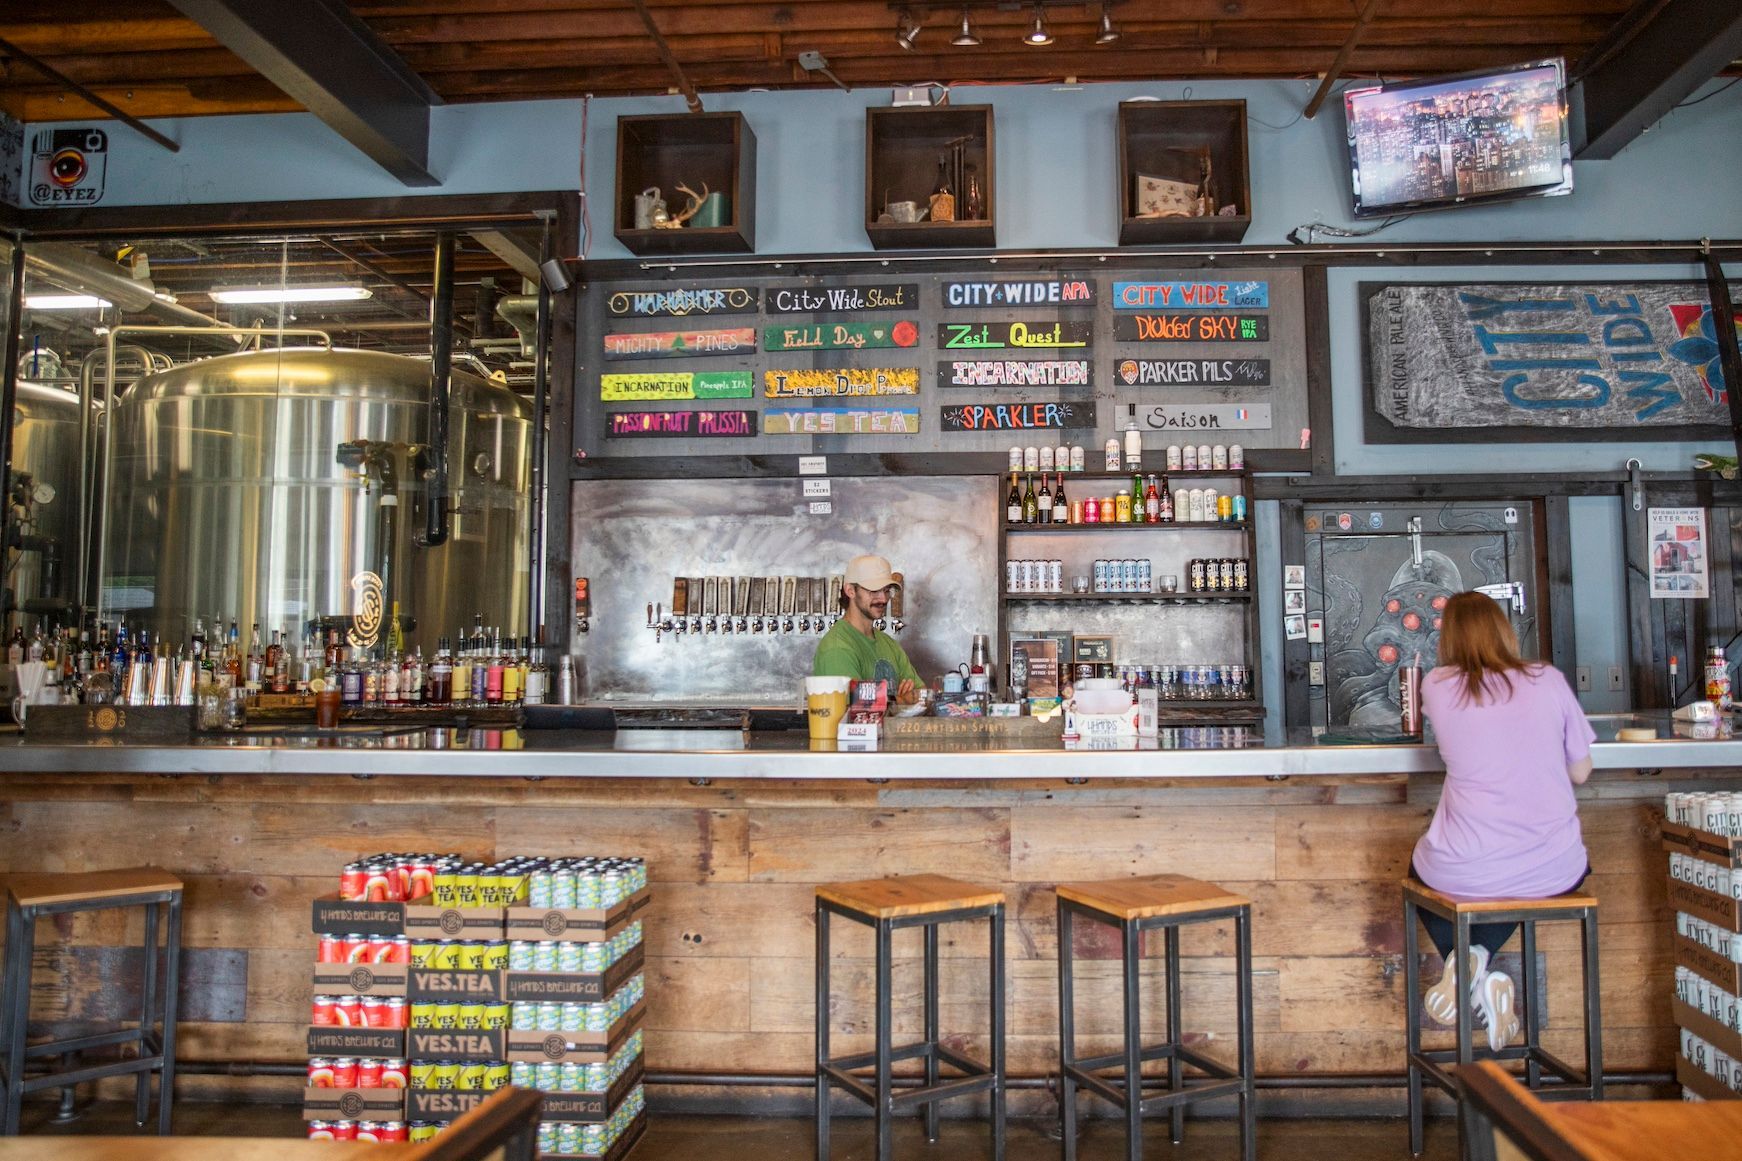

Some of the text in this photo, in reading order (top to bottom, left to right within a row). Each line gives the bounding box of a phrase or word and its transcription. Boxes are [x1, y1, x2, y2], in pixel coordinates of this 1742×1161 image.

[33, 184, 97, 201] @EYEZ
[776, 286, 904, 311] City Wide Stout
[949, 281, 1090, 305] CITY WIDE APA
[1122, 284, 1229, 305] CITY WIDE
[1234, 297, 1261, 306] LAGER
[1200, 316, 1237, 339] SKY
[1240, 319, 1257, 329] RYE
[1241, 329, 1257, 338] IPA
[696, 334, 738, 351] PINES
[833, 326, 866, 348] Day
[946, 322, 1086, 348] Zest Quest
[1387, 290, 1409, 421] AMERICAN PALE ALE
[1456, 291, 1611, 411] CITY
[1583, 290, 1684, 423] WIDE
[952, 361, 1088, 385] INCARNATION
[1139, 361, 1199, 383] PARKER
[1202, 361, 1233, 382] PILS
[615, 382, 689, 393] INCARNATION
[613, 412, 750, 434] PASSIONFRUIT PRUSSIA
[784, 411, 907, 432] YES TEA
[963, 404, 1063, 429] SPARKLER
[1147, 407, 1221, 428] Saison
[438, 893, 455, 902] TEA
[460, 893, 477, 902] TEA
[483, 894, 500, 903] TEA
[500, 895, 518, 903] TEA
[415, 973, 494, 992] YES.TEA
[415, 1034, 493, 1053] YES.TEA
[416, 1094, 490, 1112] YES.TE
